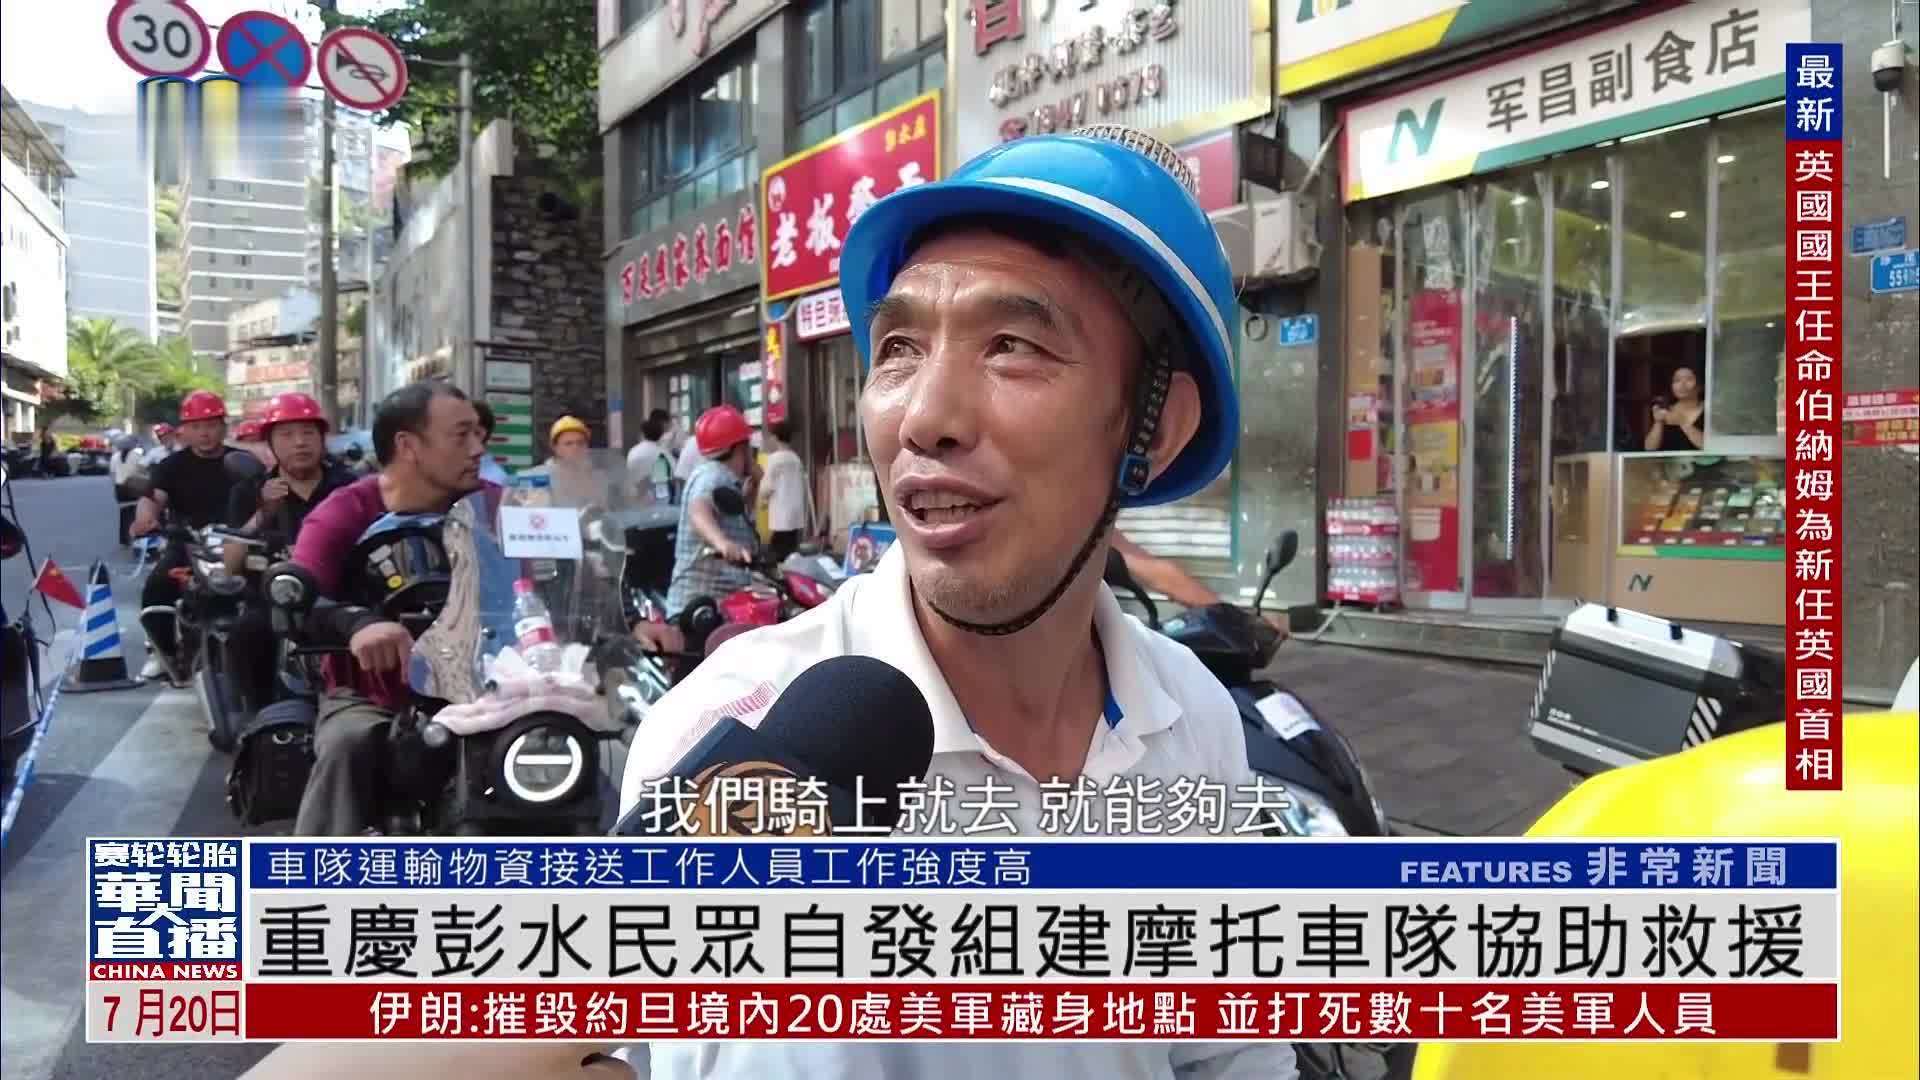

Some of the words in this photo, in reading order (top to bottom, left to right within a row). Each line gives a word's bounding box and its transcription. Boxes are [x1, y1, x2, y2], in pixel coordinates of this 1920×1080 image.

[132, 14, 192, 58] 30
[1486, 8, 1760, 133] 军昌副食店
